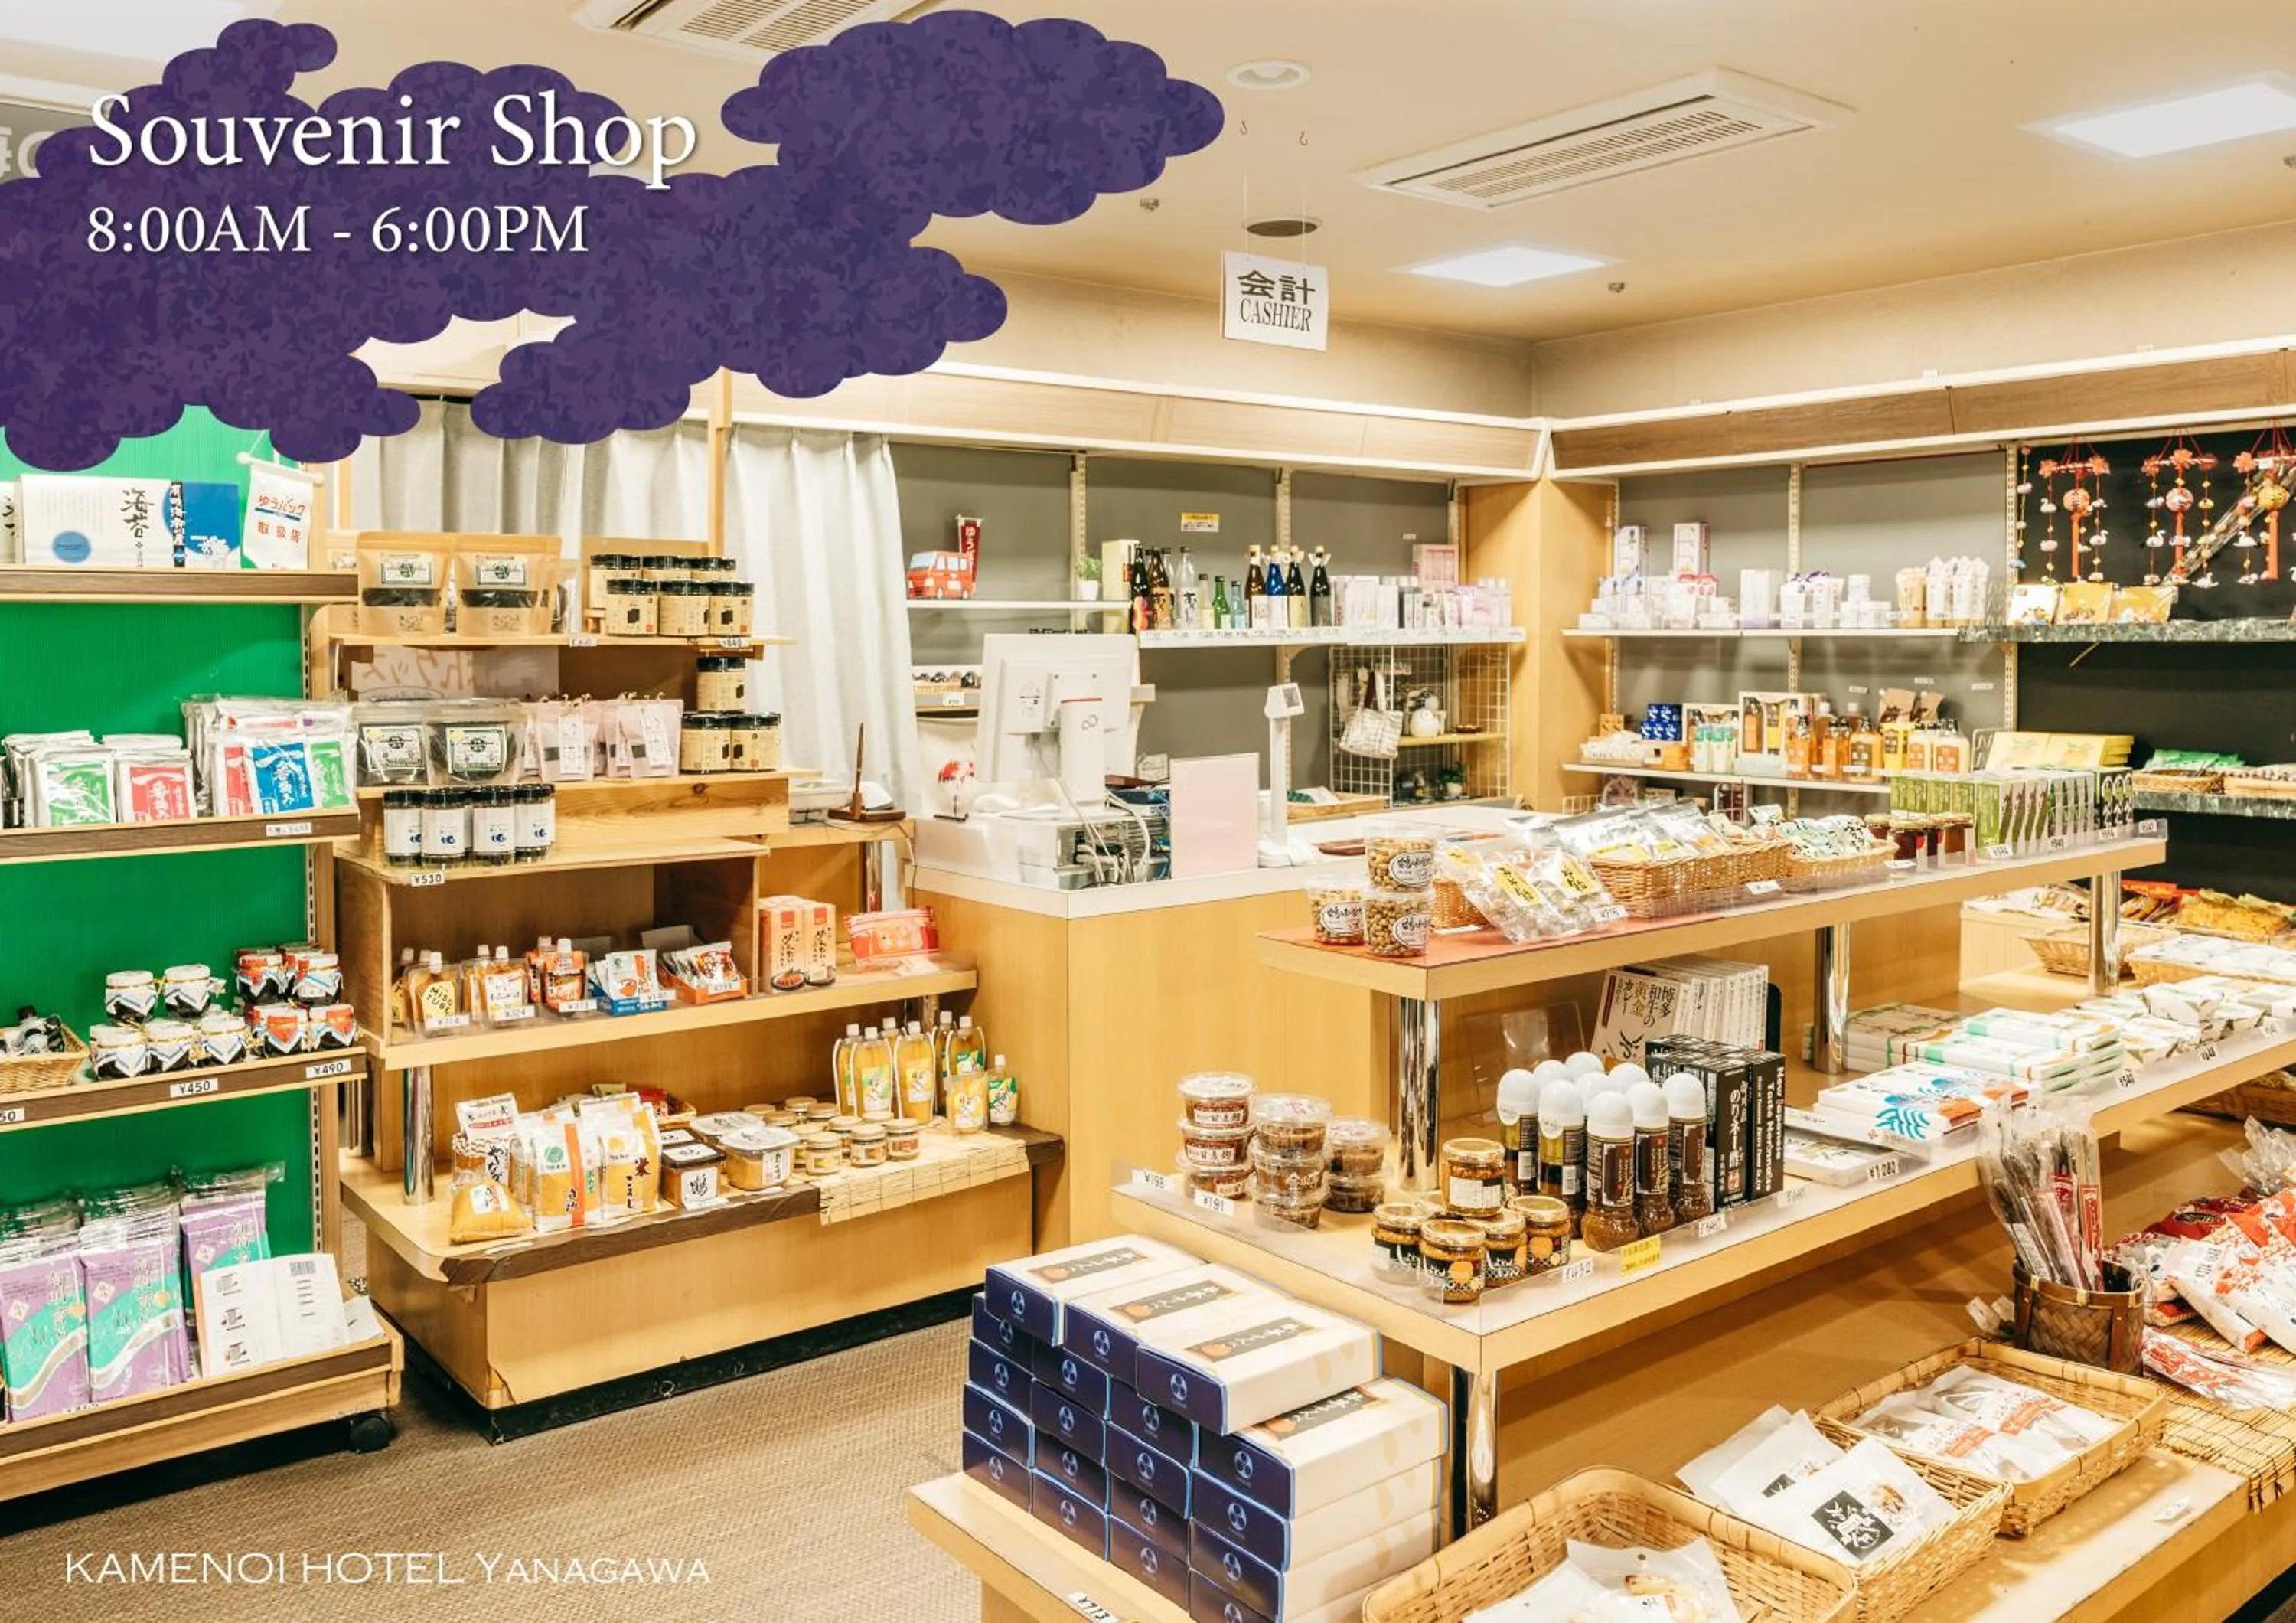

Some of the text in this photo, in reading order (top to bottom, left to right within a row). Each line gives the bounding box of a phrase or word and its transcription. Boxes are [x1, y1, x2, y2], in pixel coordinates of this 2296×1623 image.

[1236, 269, 1317, 305] 会計
[1239, 298, 1313, 331] CASHIER
[257, 493, 306, 517] ゆうパック
[414, 873, 442, 884] ¥530
[429, 985, 455, 1007] MISO
[314, 1062, 344, 1076] ¥490
[1776, 1066, 1784, 1097] New
[178, 1080, 211, 1094] ¥450
[1766, 1081, 1776, 1118] Taste
[1078, 1595, 1110, 1621] ¥713
